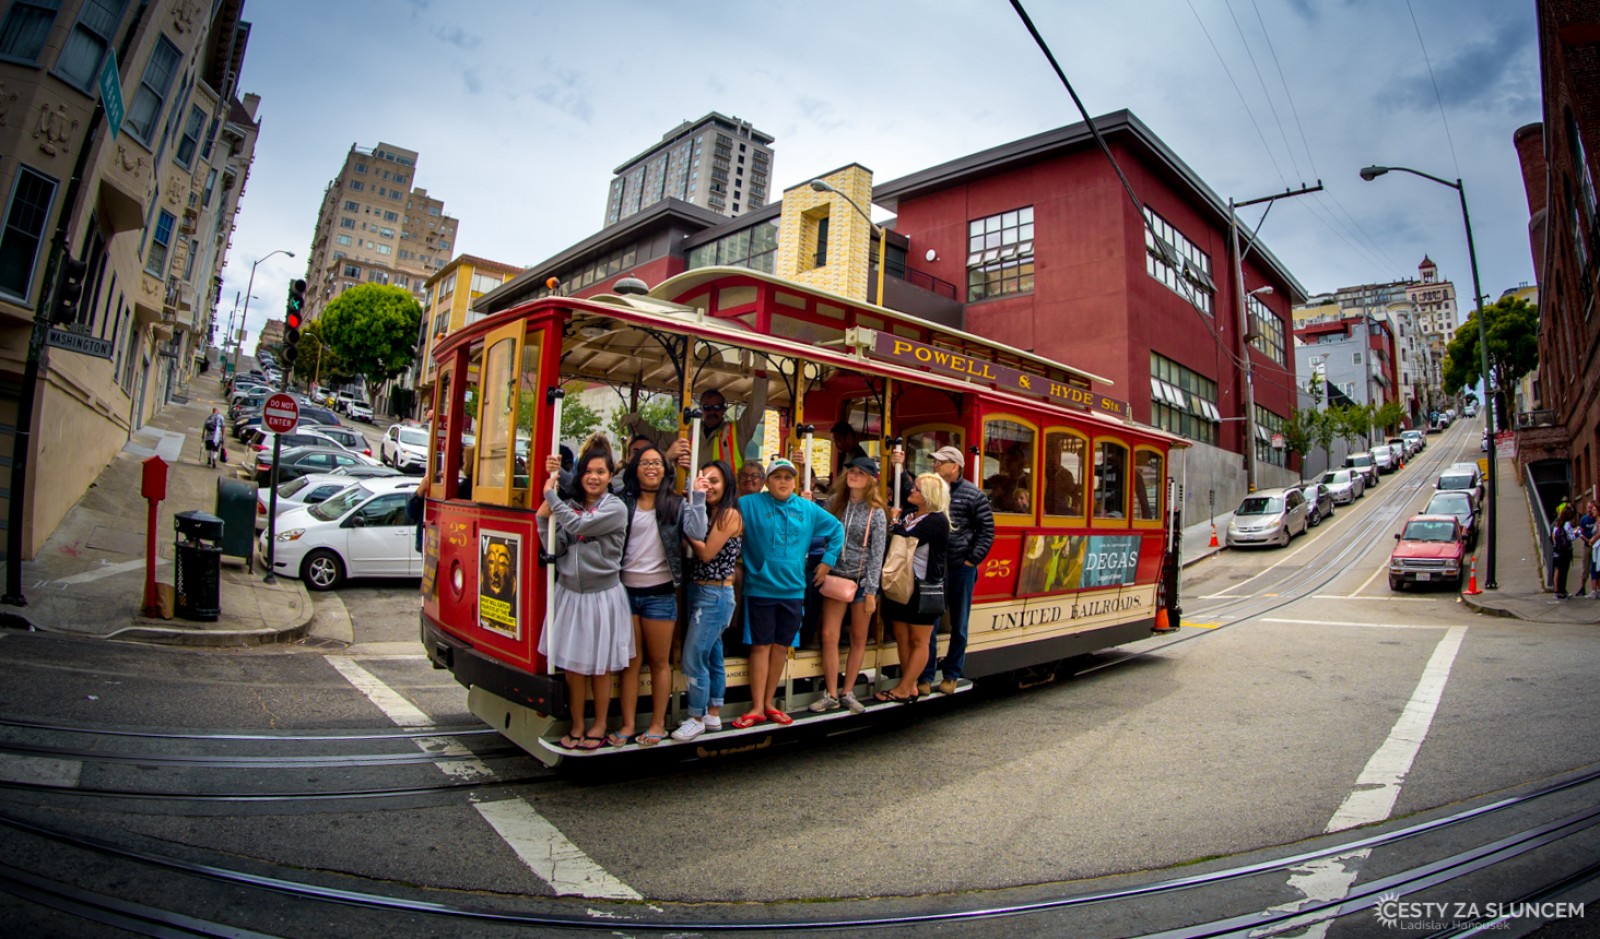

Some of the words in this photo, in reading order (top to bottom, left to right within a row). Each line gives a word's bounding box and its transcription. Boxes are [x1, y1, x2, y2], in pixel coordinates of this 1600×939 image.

[50, 332, 107, 354] WASHINGTON
[893, 340, 997, 380] POWELL
[1018, 375, 1031, 390] &
[1049, 383, 1094, 405] HYDE
[270, 400, 280, 408] DO
[281, 402, 294, 410] NOT
[269, 417, 291, 427] ENTER
[449, 522, 467, 546] 25
[985, 559, 1012, 577] 25
[1086, 551, 1138, 570] DEGAS
[992, 606, 1061, 630] UNITED
